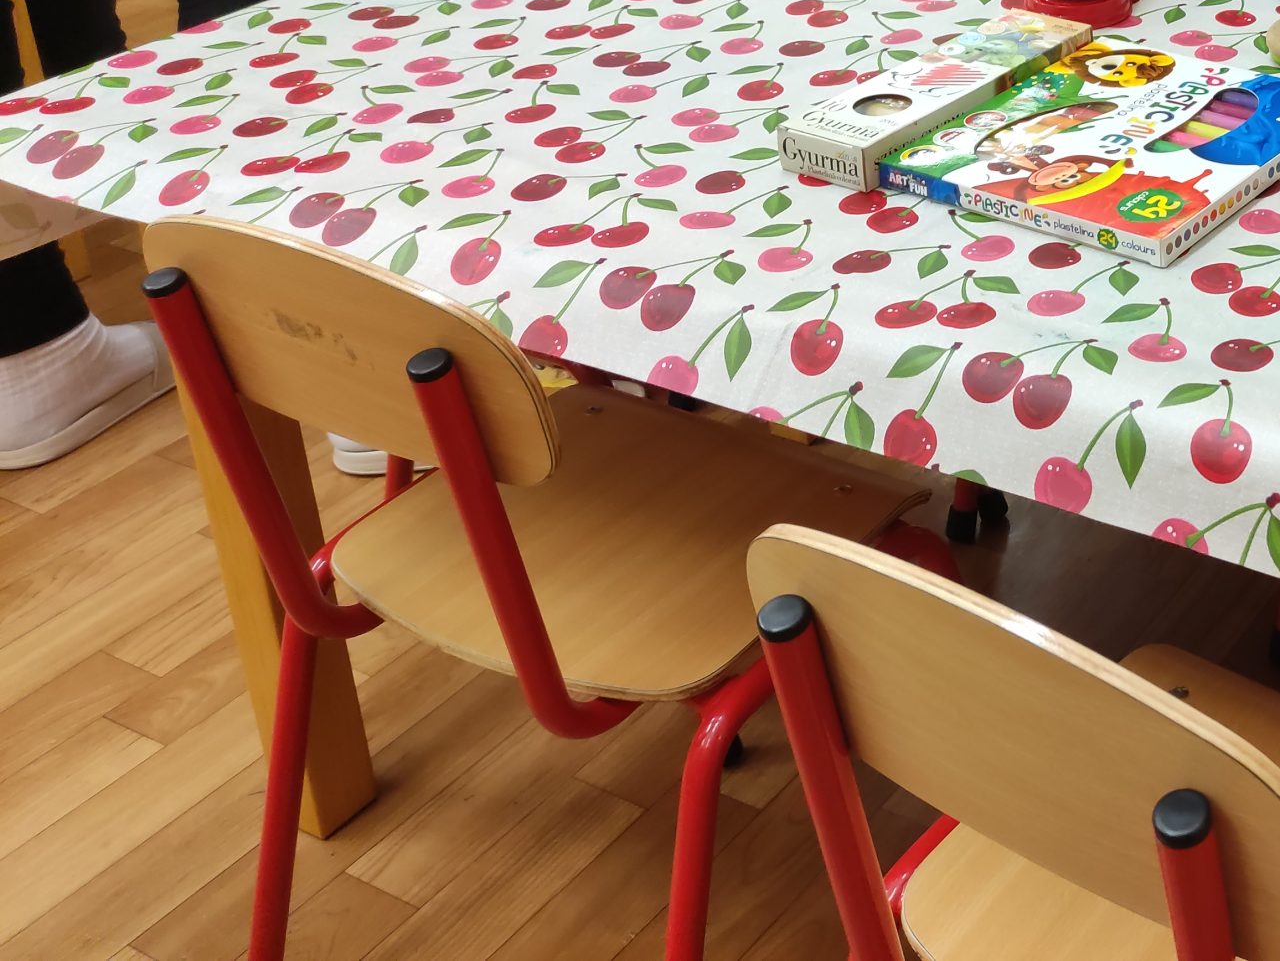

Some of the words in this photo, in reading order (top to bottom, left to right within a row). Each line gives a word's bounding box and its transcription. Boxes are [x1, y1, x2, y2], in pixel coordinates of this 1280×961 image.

[803, 110, 881, 139] Gyurma
[1100, 75, 1226, 146] PLASTICINE
[782, 136, 860, 178] Gyurma
[889, 172, 908, 186] ART
[909, 182, 928, 197] FUN
[1120, 191, 1149, 211] colours
[1131, 195, 1181, 219] 24
[973, 194, 1043, 228] PLASTICINE
[1053, 219, 1095, 238] plastelina
[1100, 231, 1116, 247] 24
[1121, 240, 1156, 256] colours
